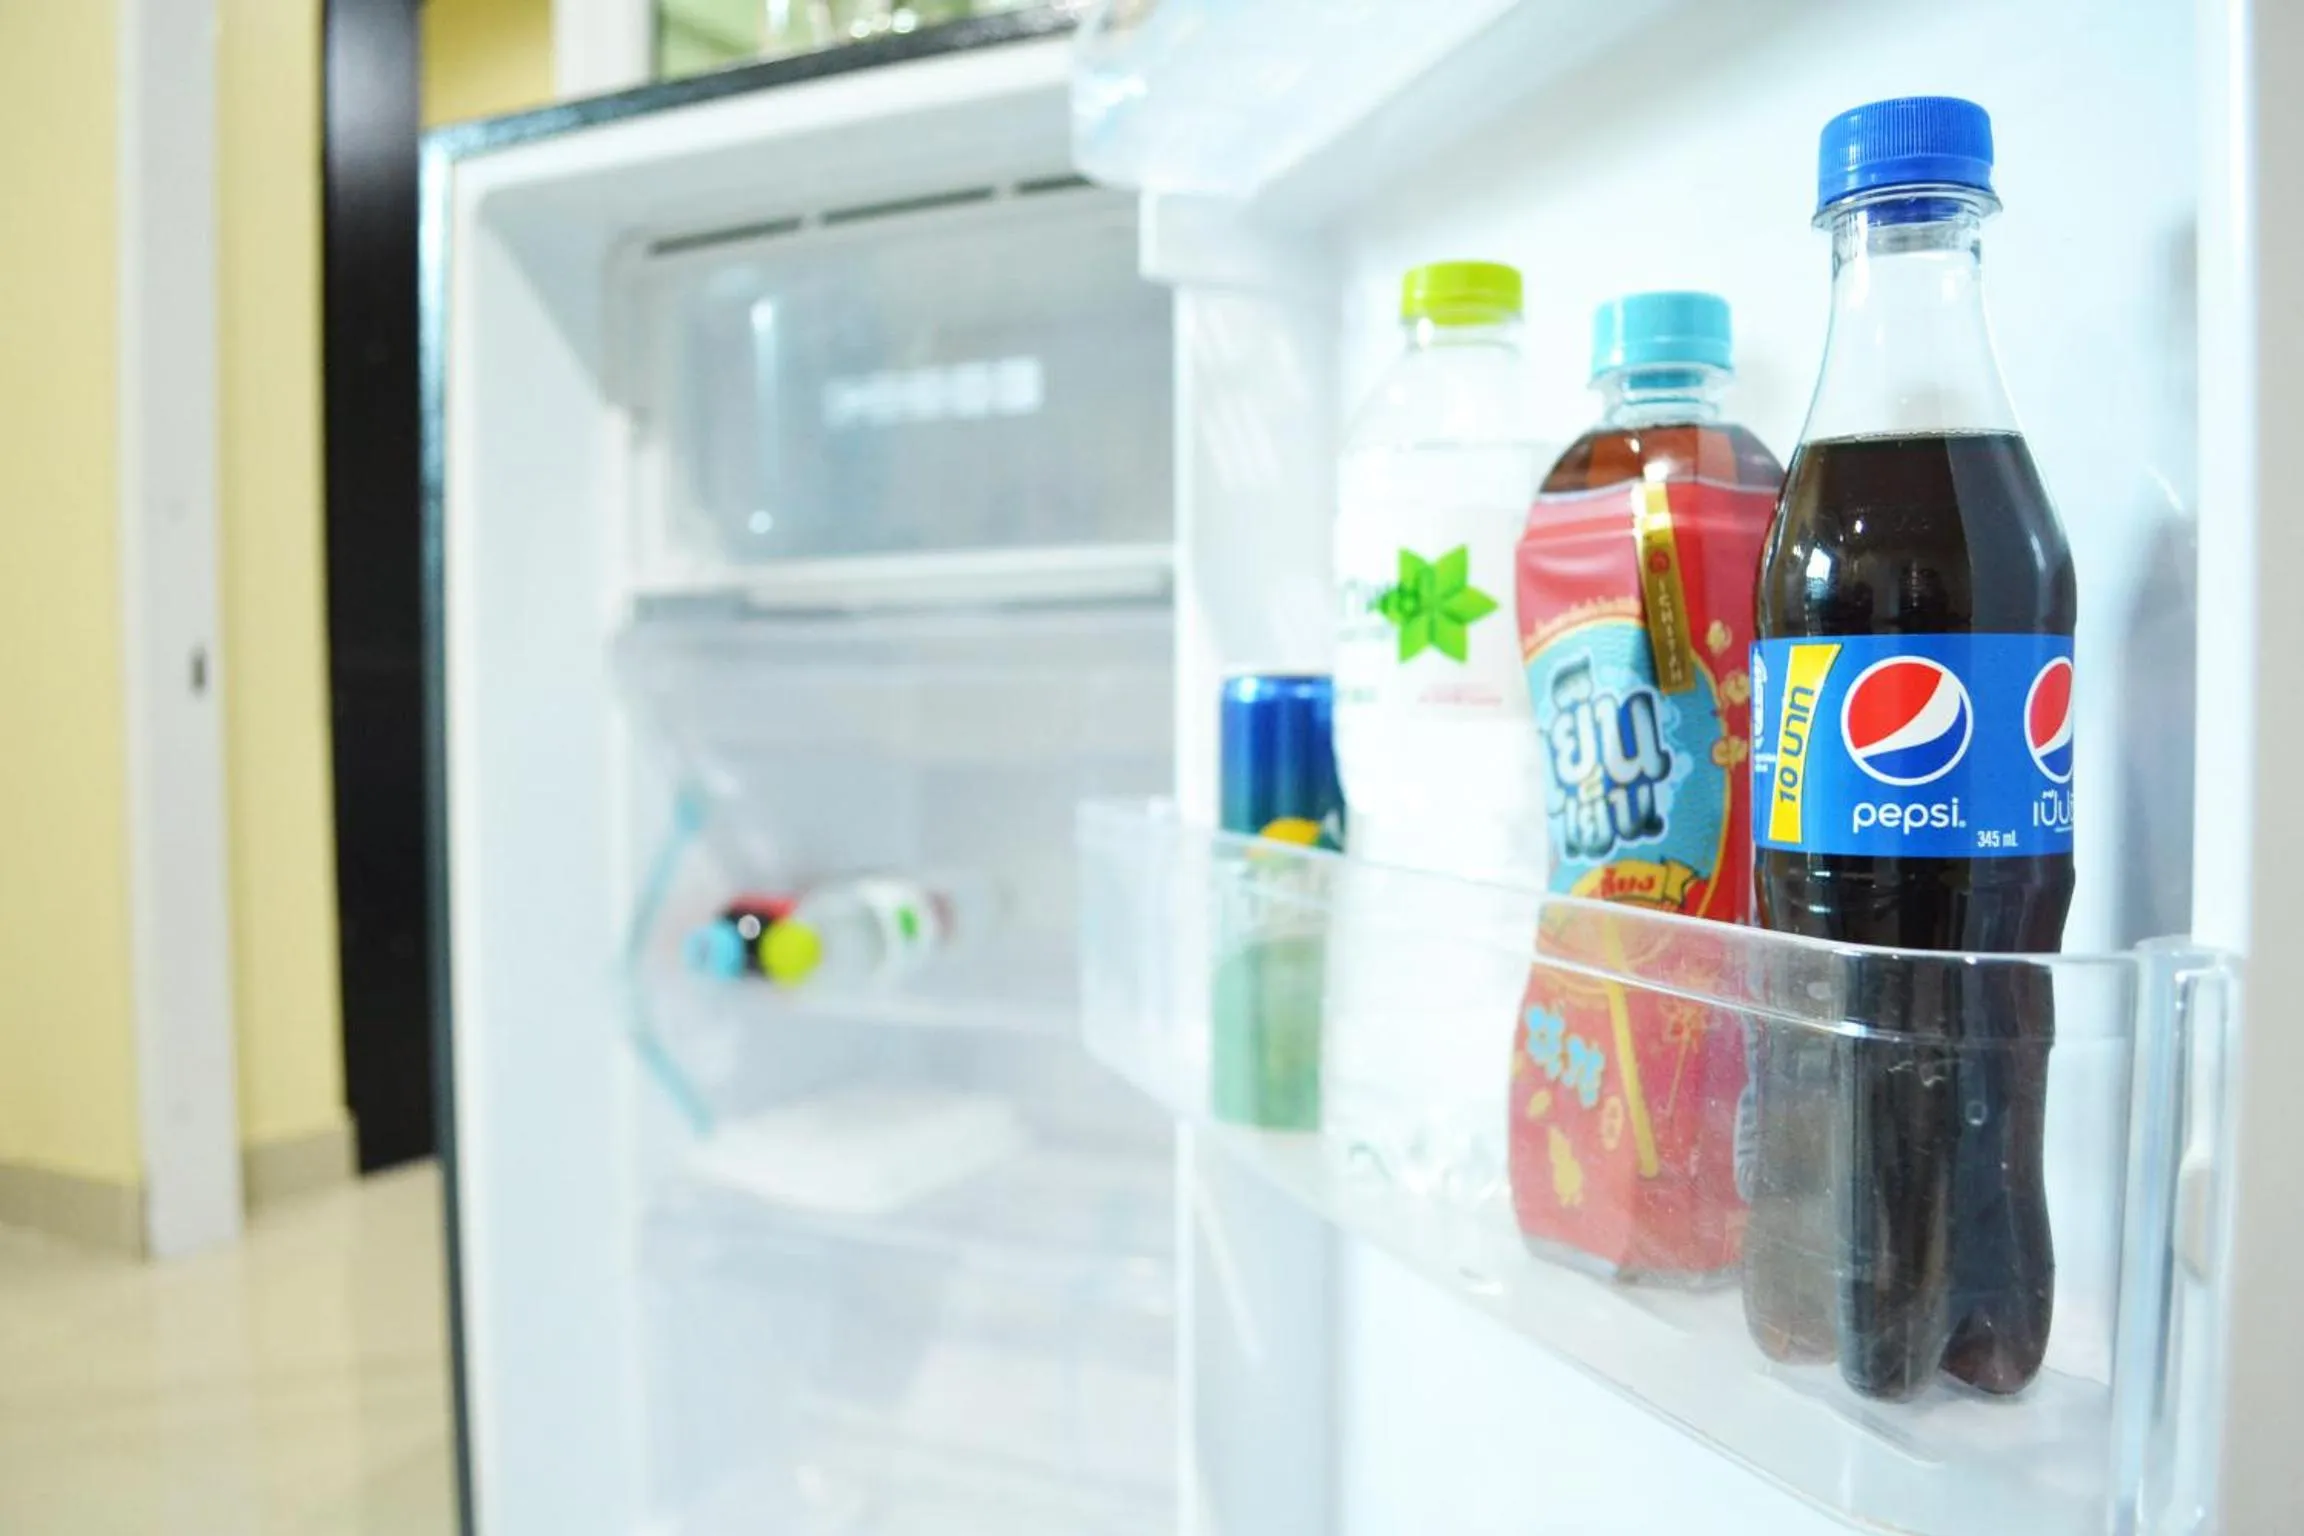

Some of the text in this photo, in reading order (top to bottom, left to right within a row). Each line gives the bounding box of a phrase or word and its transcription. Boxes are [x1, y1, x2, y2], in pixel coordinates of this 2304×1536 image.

[1779, 686, 1815, 804] 10 บาท
[1852, 797, 1959, 835] pepsi
[1977, 829, 2001, 848] 345
